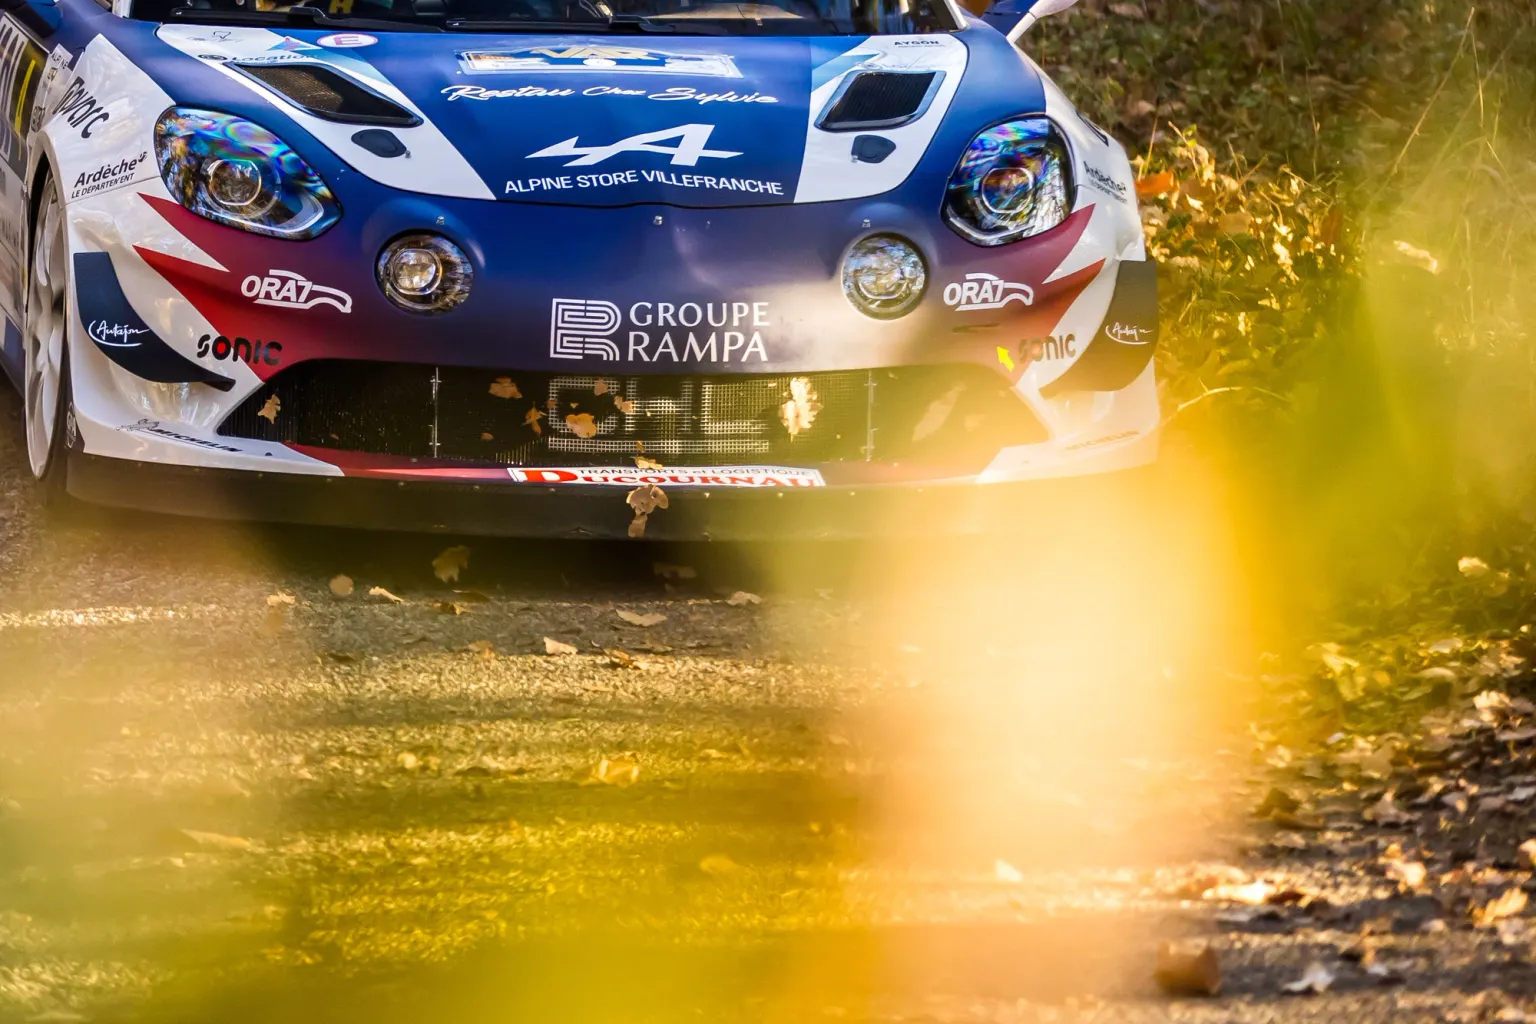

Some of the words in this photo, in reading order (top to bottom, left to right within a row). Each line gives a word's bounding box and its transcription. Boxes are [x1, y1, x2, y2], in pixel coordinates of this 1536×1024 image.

[74, 158, 138, 188] Ardèche
[505, 176, 573, 193] ALPINE
[577, 170, 639, 188] STORE
[641, 169, 784, 196] VILLEFRANCHE
[71, 189, 81, 199] LE
[629, 301, 771, 327] GROUPE
[627, 331, 769, 363] RAMPA
